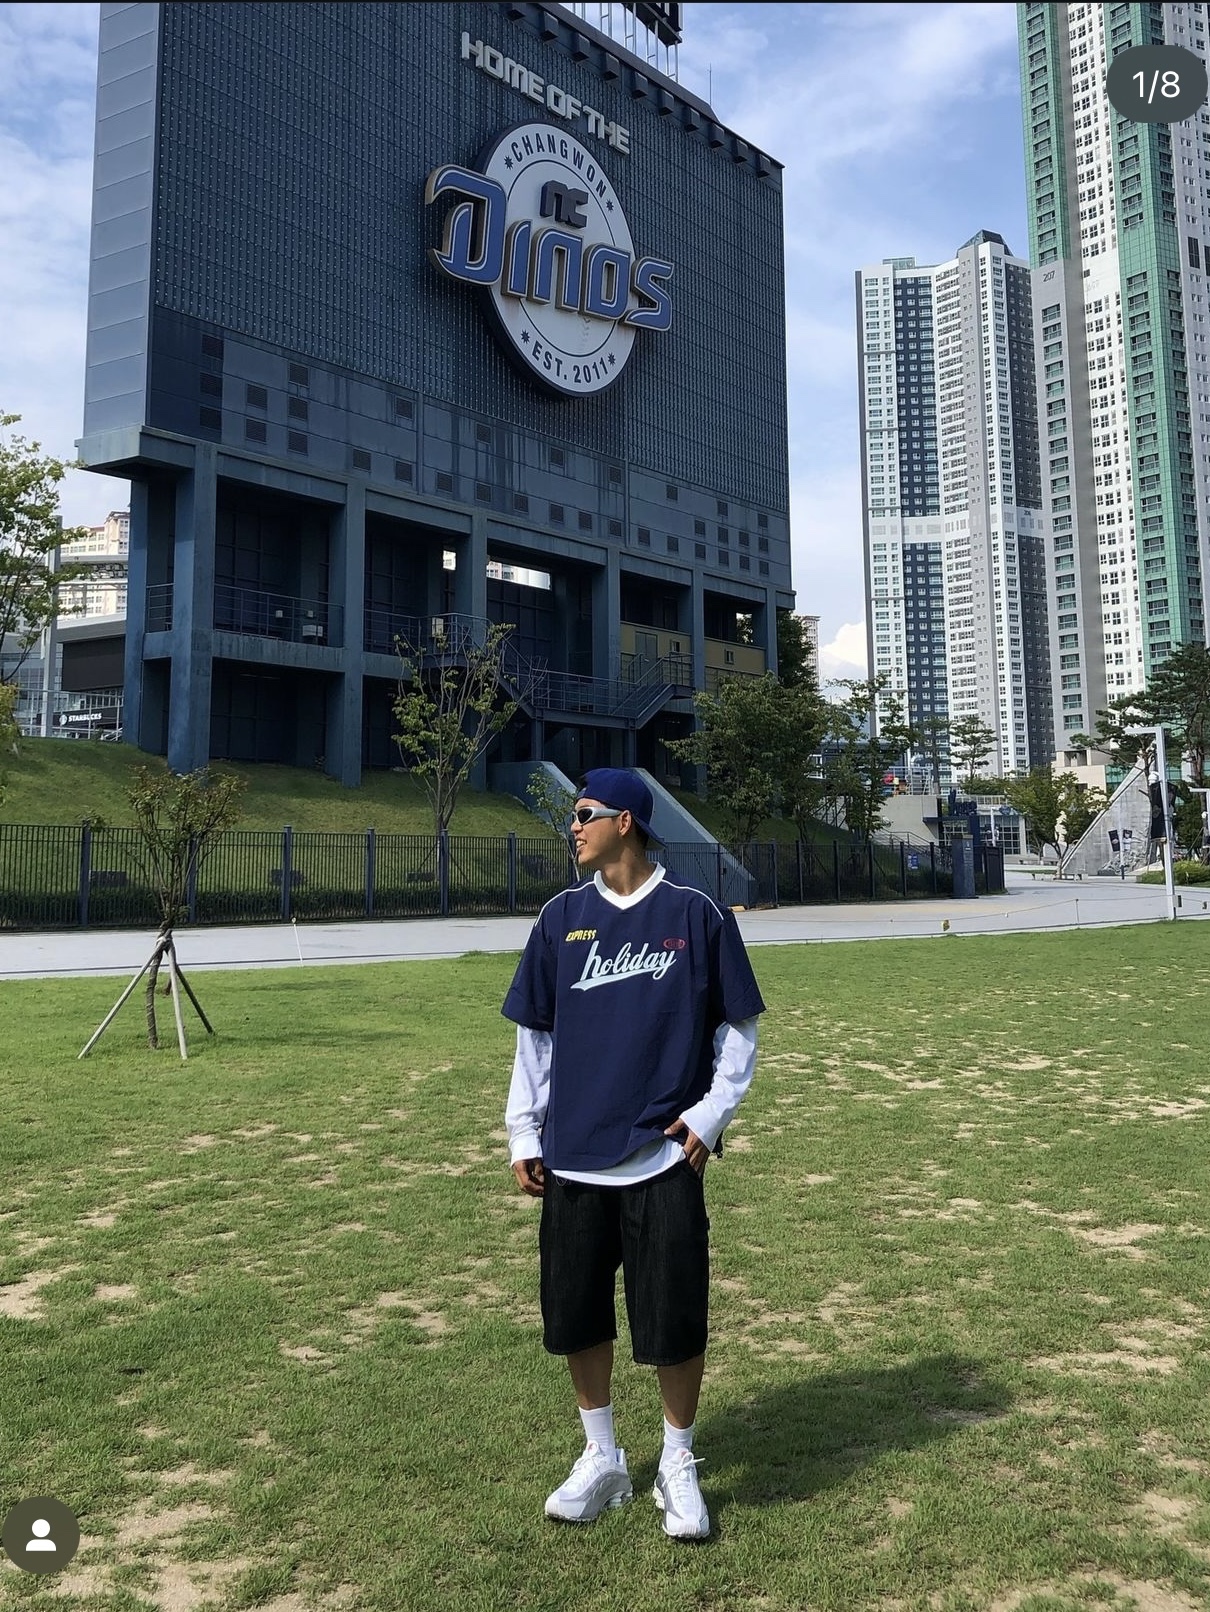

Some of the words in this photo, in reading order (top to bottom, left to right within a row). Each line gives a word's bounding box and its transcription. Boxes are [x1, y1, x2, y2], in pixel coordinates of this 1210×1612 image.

[461, 31, 545, 104] HOME
[546, 84, 582, 120] OF
[582, 105, 630, 155] THE
[511, 132, 607, 198] CHANGWON
[1043, 270, 1055, 282] 207
[532, 340, 567, 380] EST.
[573, 357, 608, 383] 2011
[565, 929, 597, 942] EXPRESS
[577, 941, 677, 981] holiday
